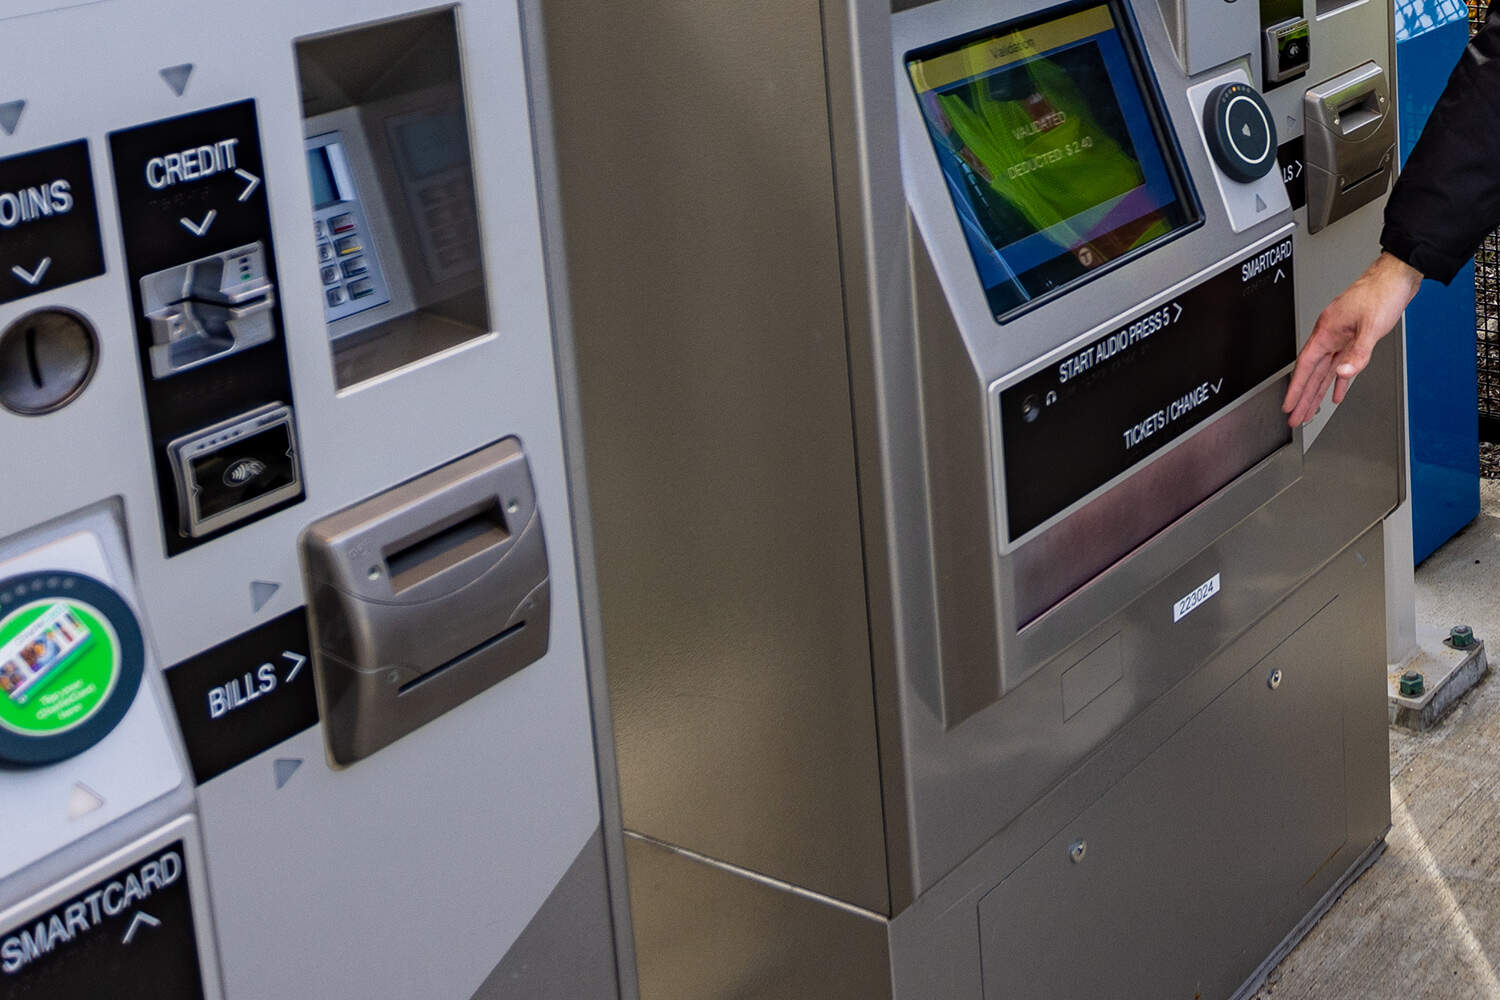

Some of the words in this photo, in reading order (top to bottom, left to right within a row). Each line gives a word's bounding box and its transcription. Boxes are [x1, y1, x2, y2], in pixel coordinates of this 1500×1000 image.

[1011, 111, 1066, 140] VALIDATED
[145, 138, 239, 190] CREDIT
[1241, 240, 1292, 283] SMARTCARD
[1058, 348, 1095, 384] START
[1095, 332, 1128, 365] AUDIO
[1129, 314, 1162, 346] PRESS
[1162, 307, 1171, 326] 5
[1122, 411, 1165, 450] TICKETS
[1169, 381, 1210, 421] CHANGE
[1179, 580, 1214, 615] 223024
[208, 662, 279, 720] BILLS
[1, 851, 182, 975] SMARTCARD
